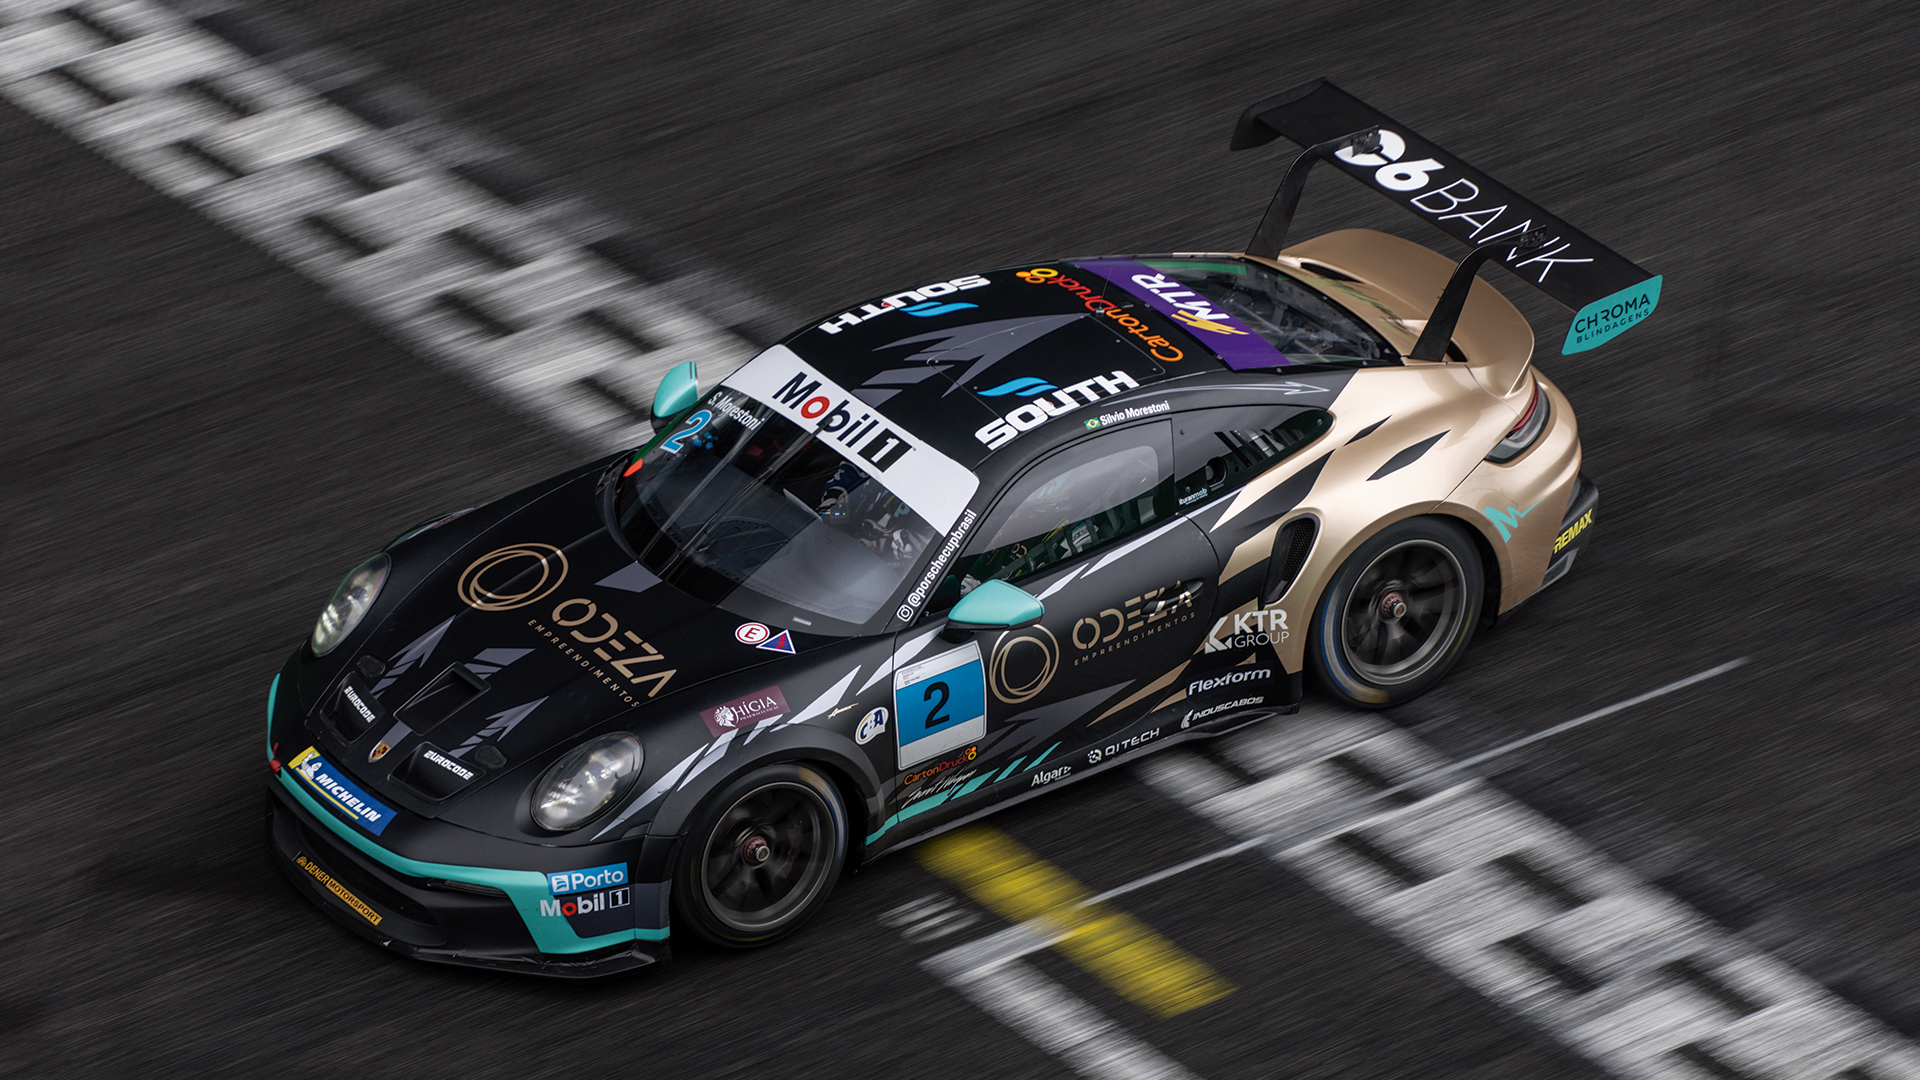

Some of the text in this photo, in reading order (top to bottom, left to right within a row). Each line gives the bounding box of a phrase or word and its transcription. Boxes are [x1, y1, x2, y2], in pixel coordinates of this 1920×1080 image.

[1410, 178, 1594, 283] BANK
[818, 275, 991, 334] SOUTH
[1131, 273, 1230, 320] MTR
[1574, 293, 1650, 333] CHROMA
[1576, 308, 1649, 344] BLINDAGENS
[707, 391, 765, 430] S. Morestoni
[772, 371, 880, 449] Mobil
[974, 370, 1140, 450] SOUTH
[1100, 400, 1171, 426] Silvio Morestoni
[660, 410, 713, 454] 2
[1553, 508, 1592, 554] REMAX
[907, 508, 977, 608] @porschecupbrasil
[743, 627, 761, 640] E
[1072, 580, 1194, 650] ODEZA
[1234, 609, 1289, 635] KTR
[552, 598, 678, 698] ODEZA
[1074, 611, 1196, 667] EMPREENDIMENTOS
[1234, 631, 1290, 648] GROUP
[527, 619, 640, 708] EMPREENDIMENTOS
[1188, 668, 1271, 696] Flexform
[343, 685, 377, 724] EUROCODE
[923, 681, 950, 730] 2
[1192, 696, 1265, 721] INDUSCABOS
[423, 750, 474, 781] EUROCODE
[904, 754, 969, 785] CartonDruck
[1031, 766, 1064, 788] Algar
[315, 773, 382, 823] MICHELIN
[304, 861, 380, 923] DENER MOTORSPORT
[571, 869, 624, 890] Porto
[540, 892, 605, 917] Mobil
